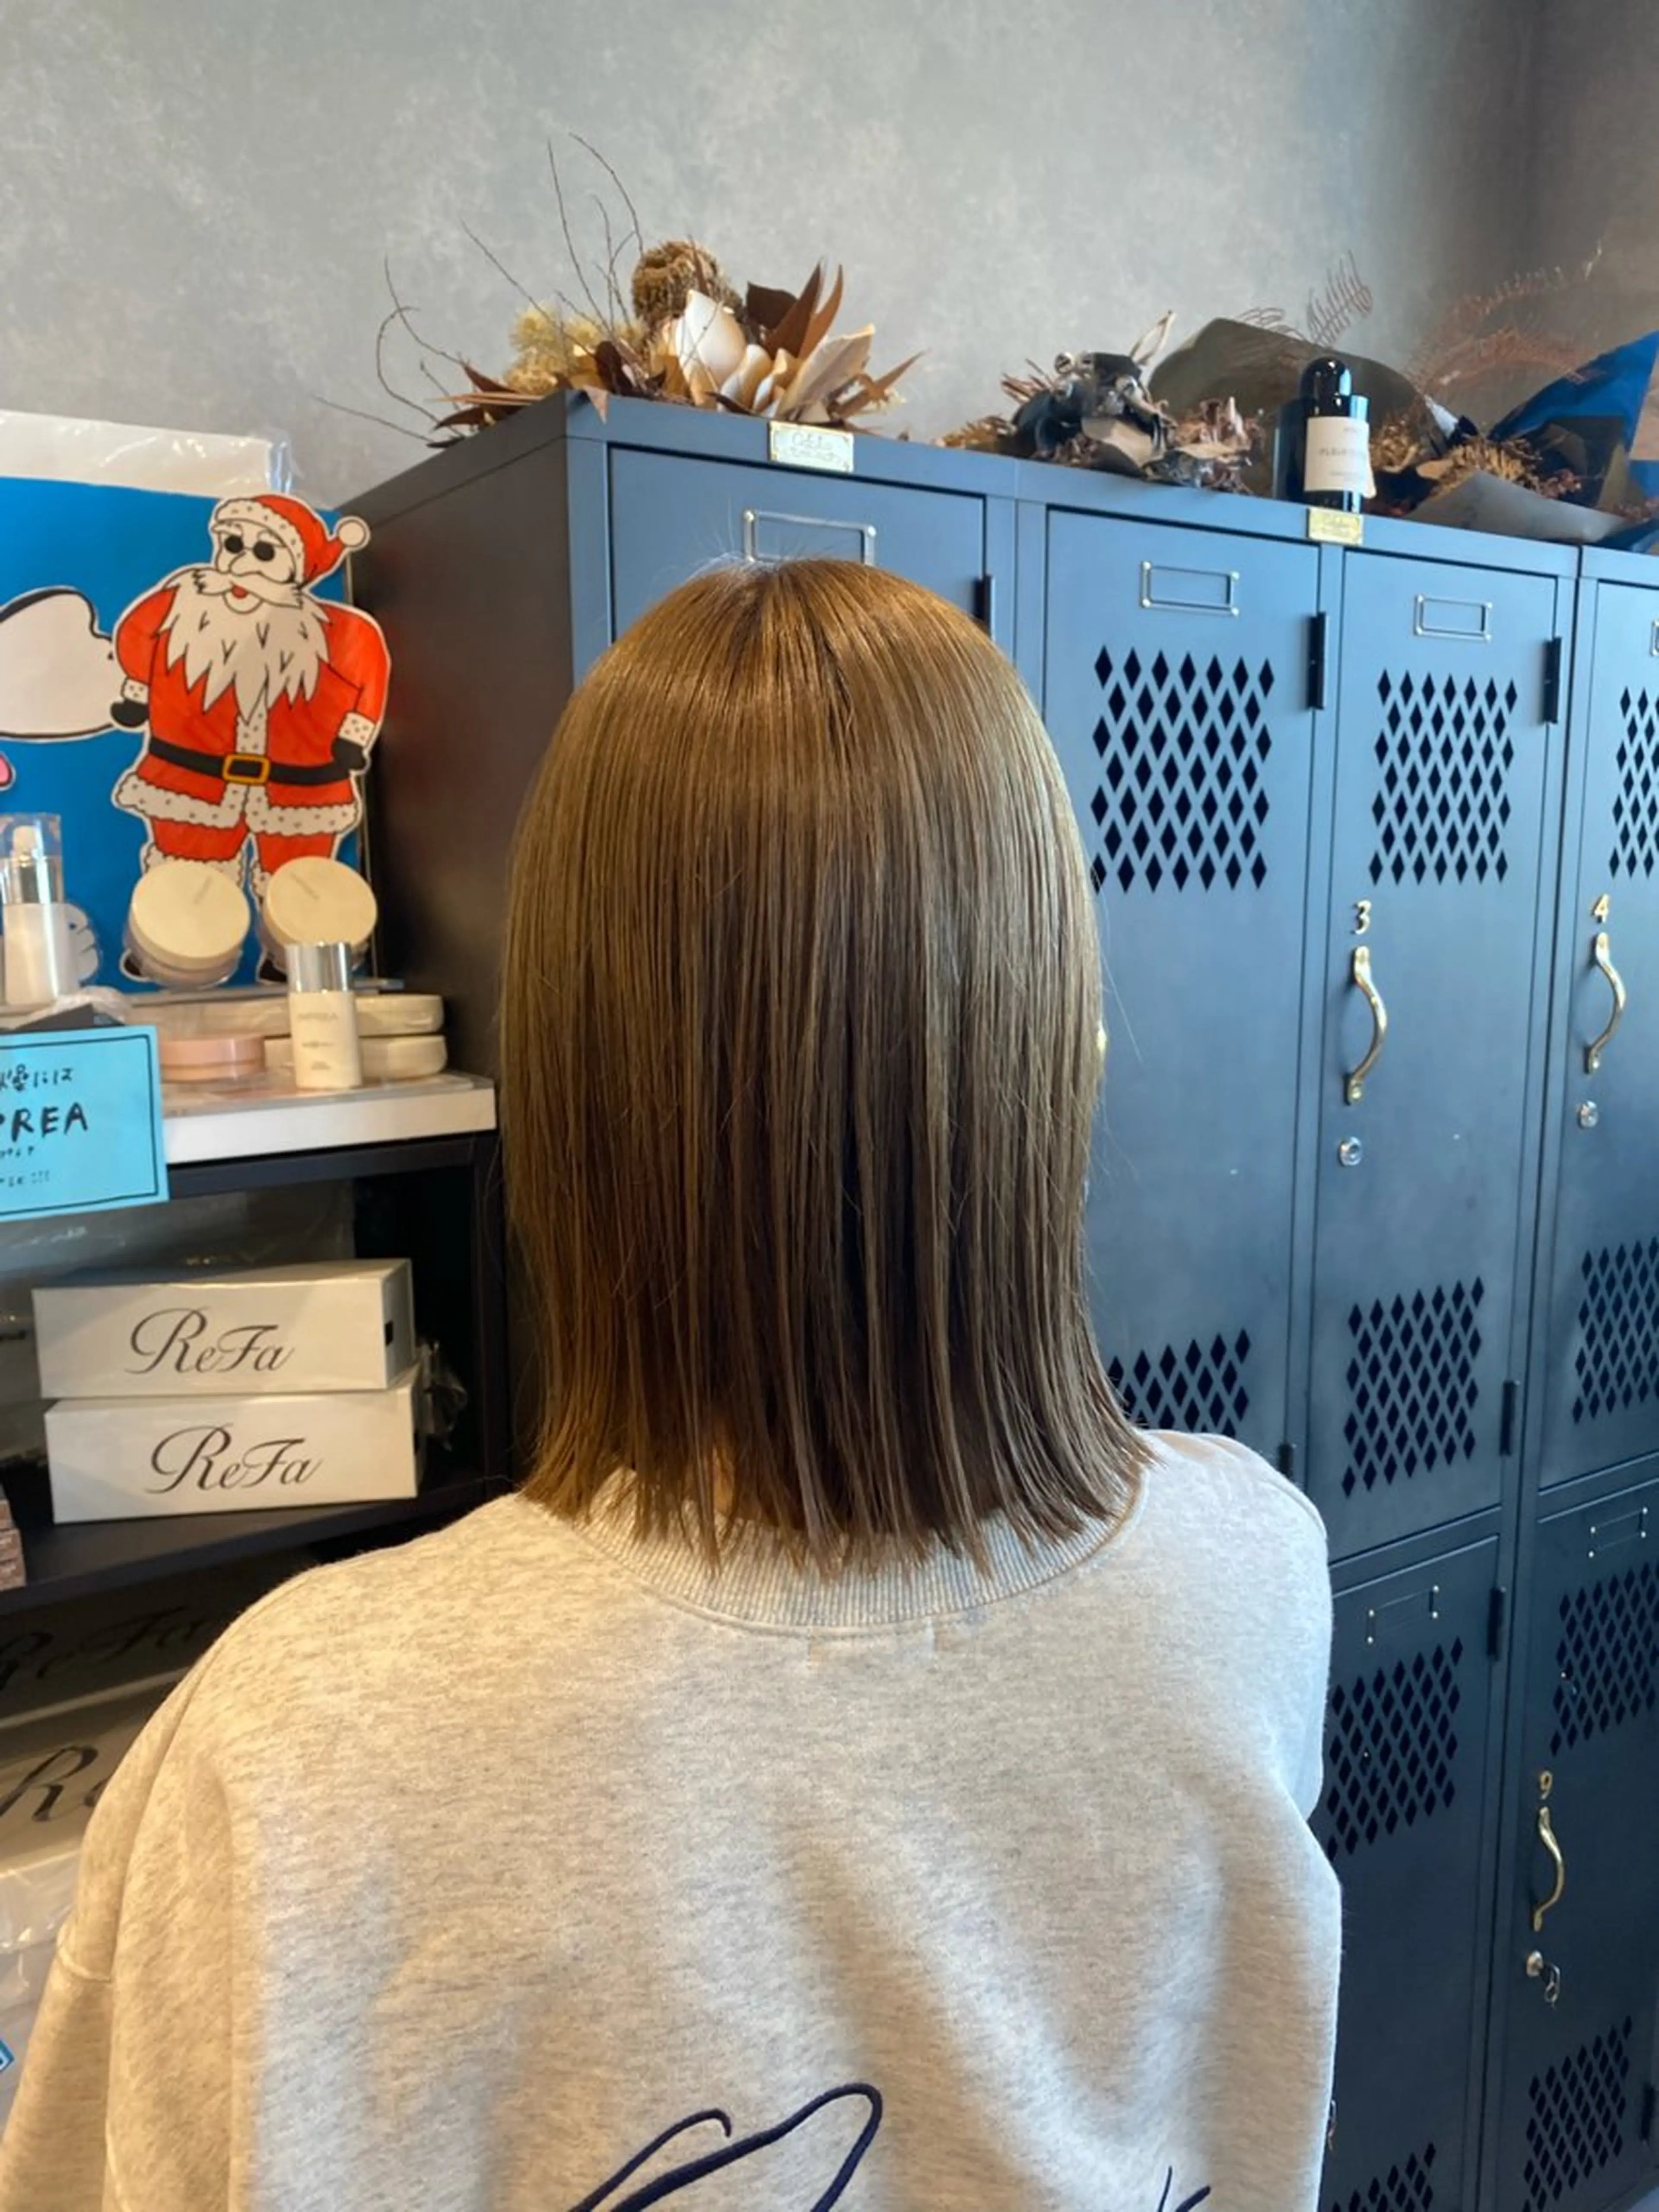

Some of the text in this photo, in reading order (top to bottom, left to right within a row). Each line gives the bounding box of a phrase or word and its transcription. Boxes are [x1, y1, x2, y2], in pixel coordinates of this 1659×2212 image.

[1352, 900, 1372, 934] 3
[1591, 893, 1610, 923] 4
[0, 1102, 89, 1142] REA
[124, 1307, 296, 1374] ReFa
[145, 1422, 324, 1494] ReFa
[1540, 1770, 1552, 1800] 9
